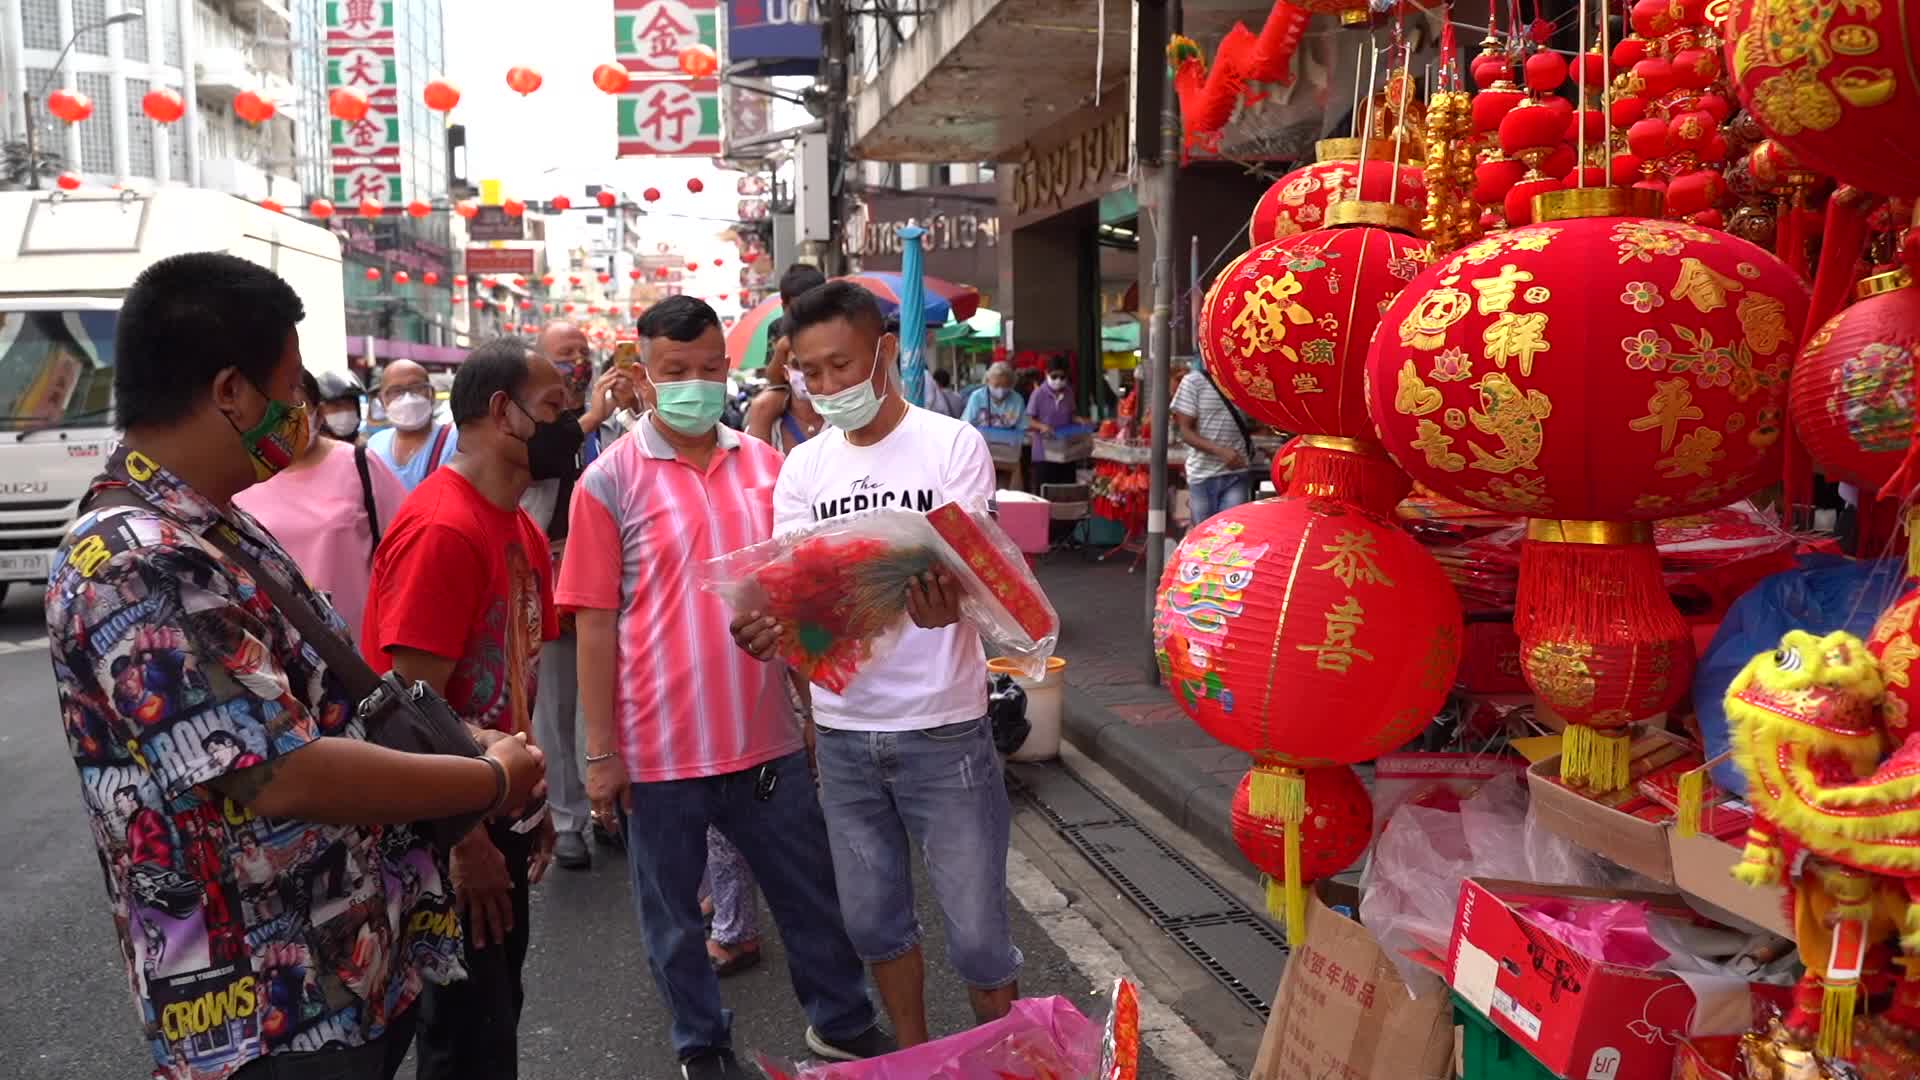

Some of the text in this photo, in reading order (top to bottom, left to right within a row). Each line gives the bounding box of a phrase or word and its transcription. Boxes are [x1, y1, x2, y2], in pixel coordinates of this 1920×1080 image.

[637, 5, 696, 144] 金行
[1471, 263, 1551, 377] 吉祥
[1394, 358, 1467, 473] 如意
[1629, 376, 1726, 478] 平安
[0, 482, 48, 494] UZU
[850, 475, 885, 494] The
[1296, 529, 1396, 674] 恭喜
[1461, 886, 1477, 934] APPLE
